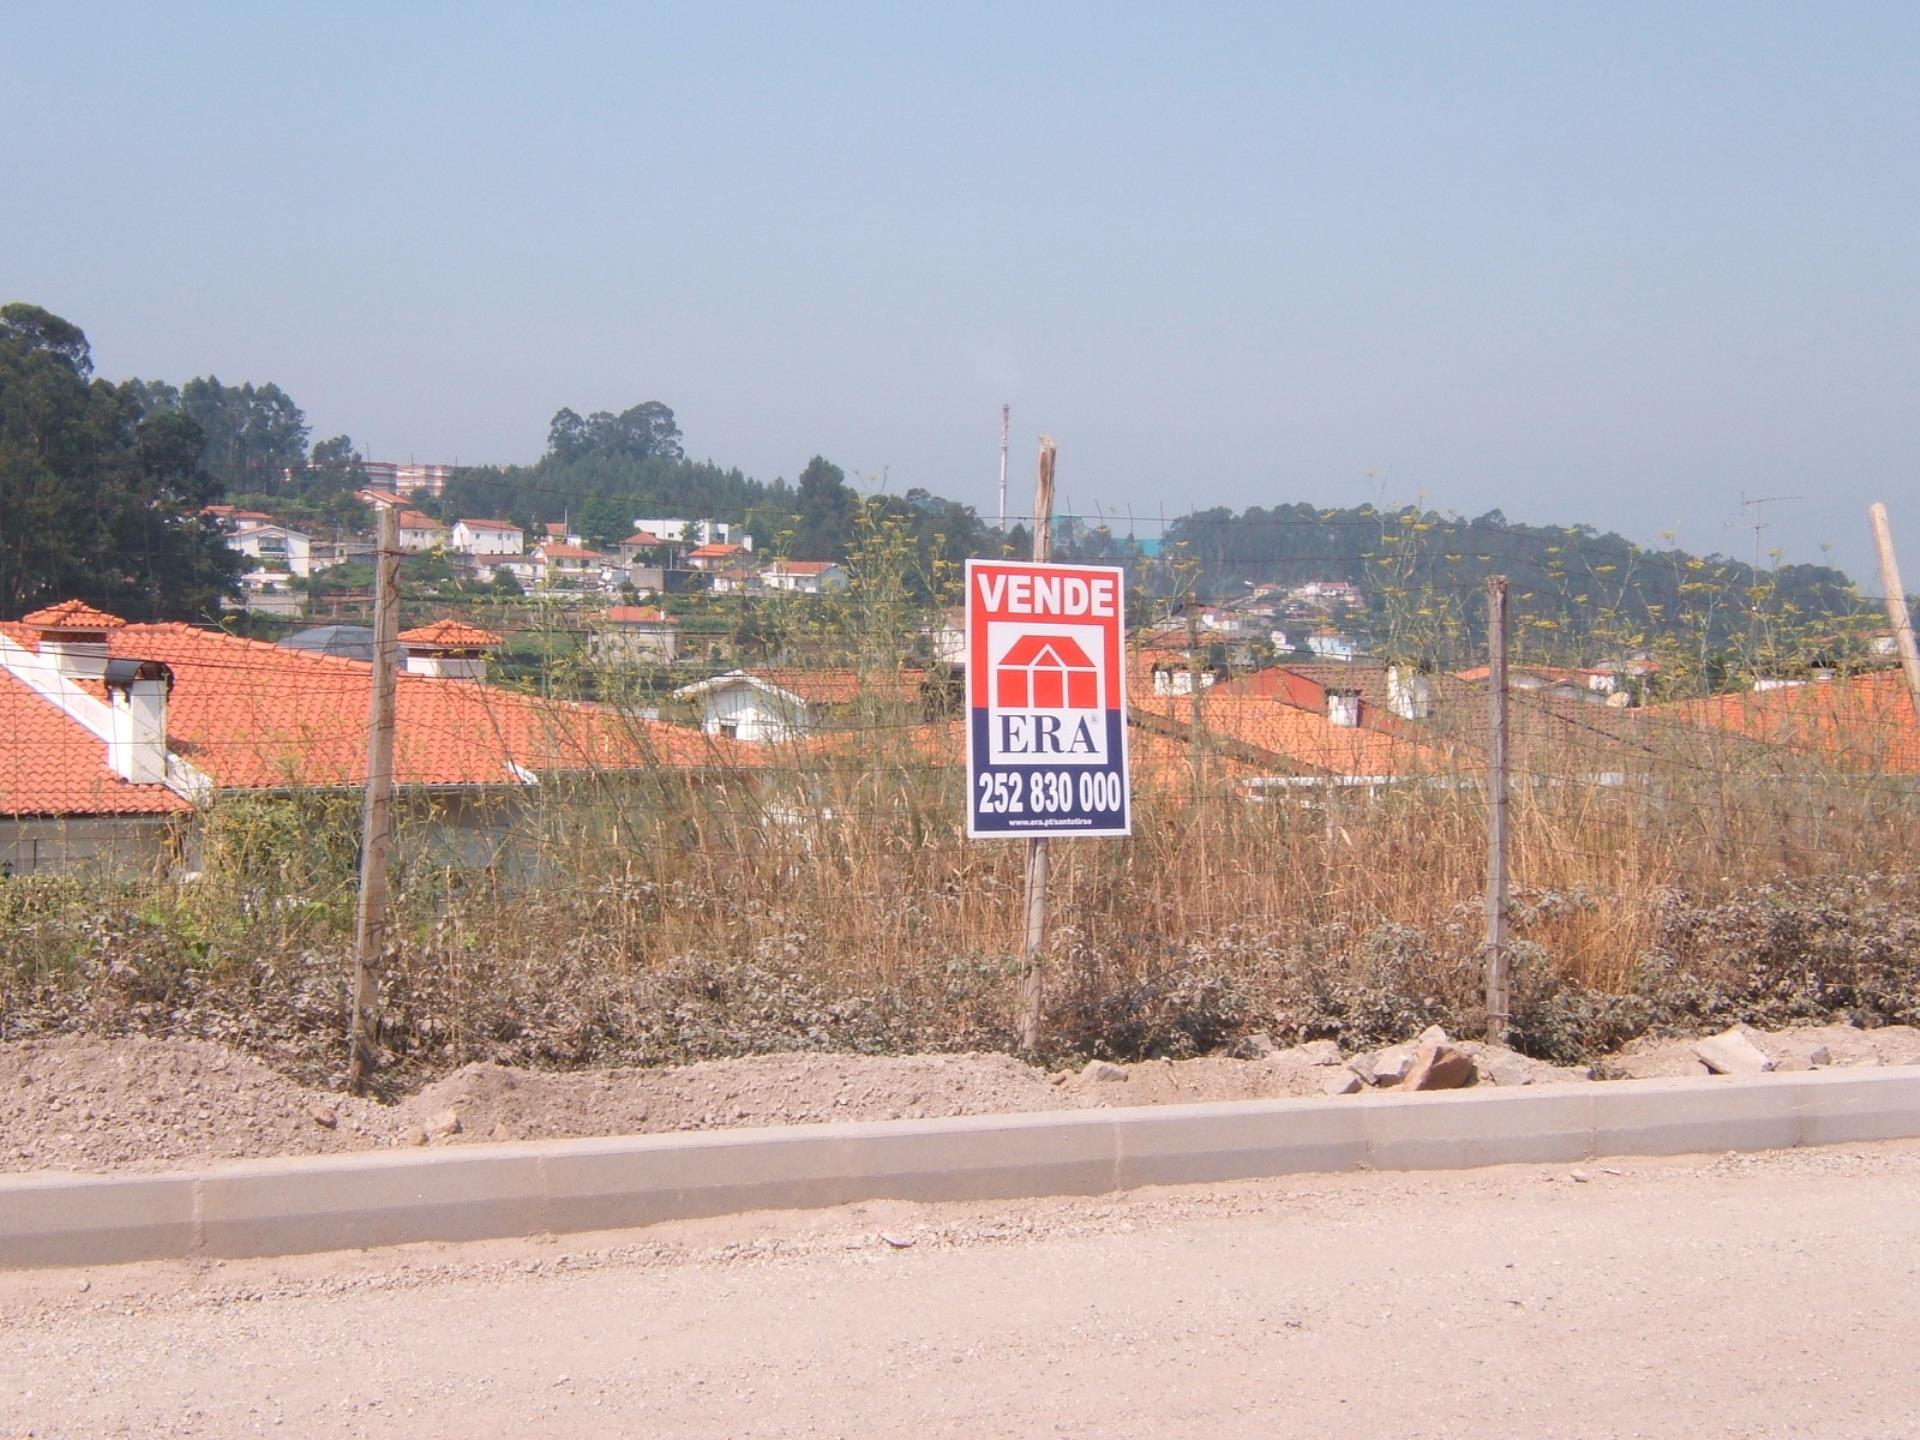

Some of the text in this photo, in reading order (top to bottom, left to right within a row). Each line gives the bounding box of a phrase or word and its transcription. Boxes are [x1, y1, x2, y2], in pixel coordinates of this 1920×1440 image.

[977, 573, 1114, 617] VENDE
[997, 714, 1100, 754] ERA
[979, 771, 1121, 813] 252 830 000
